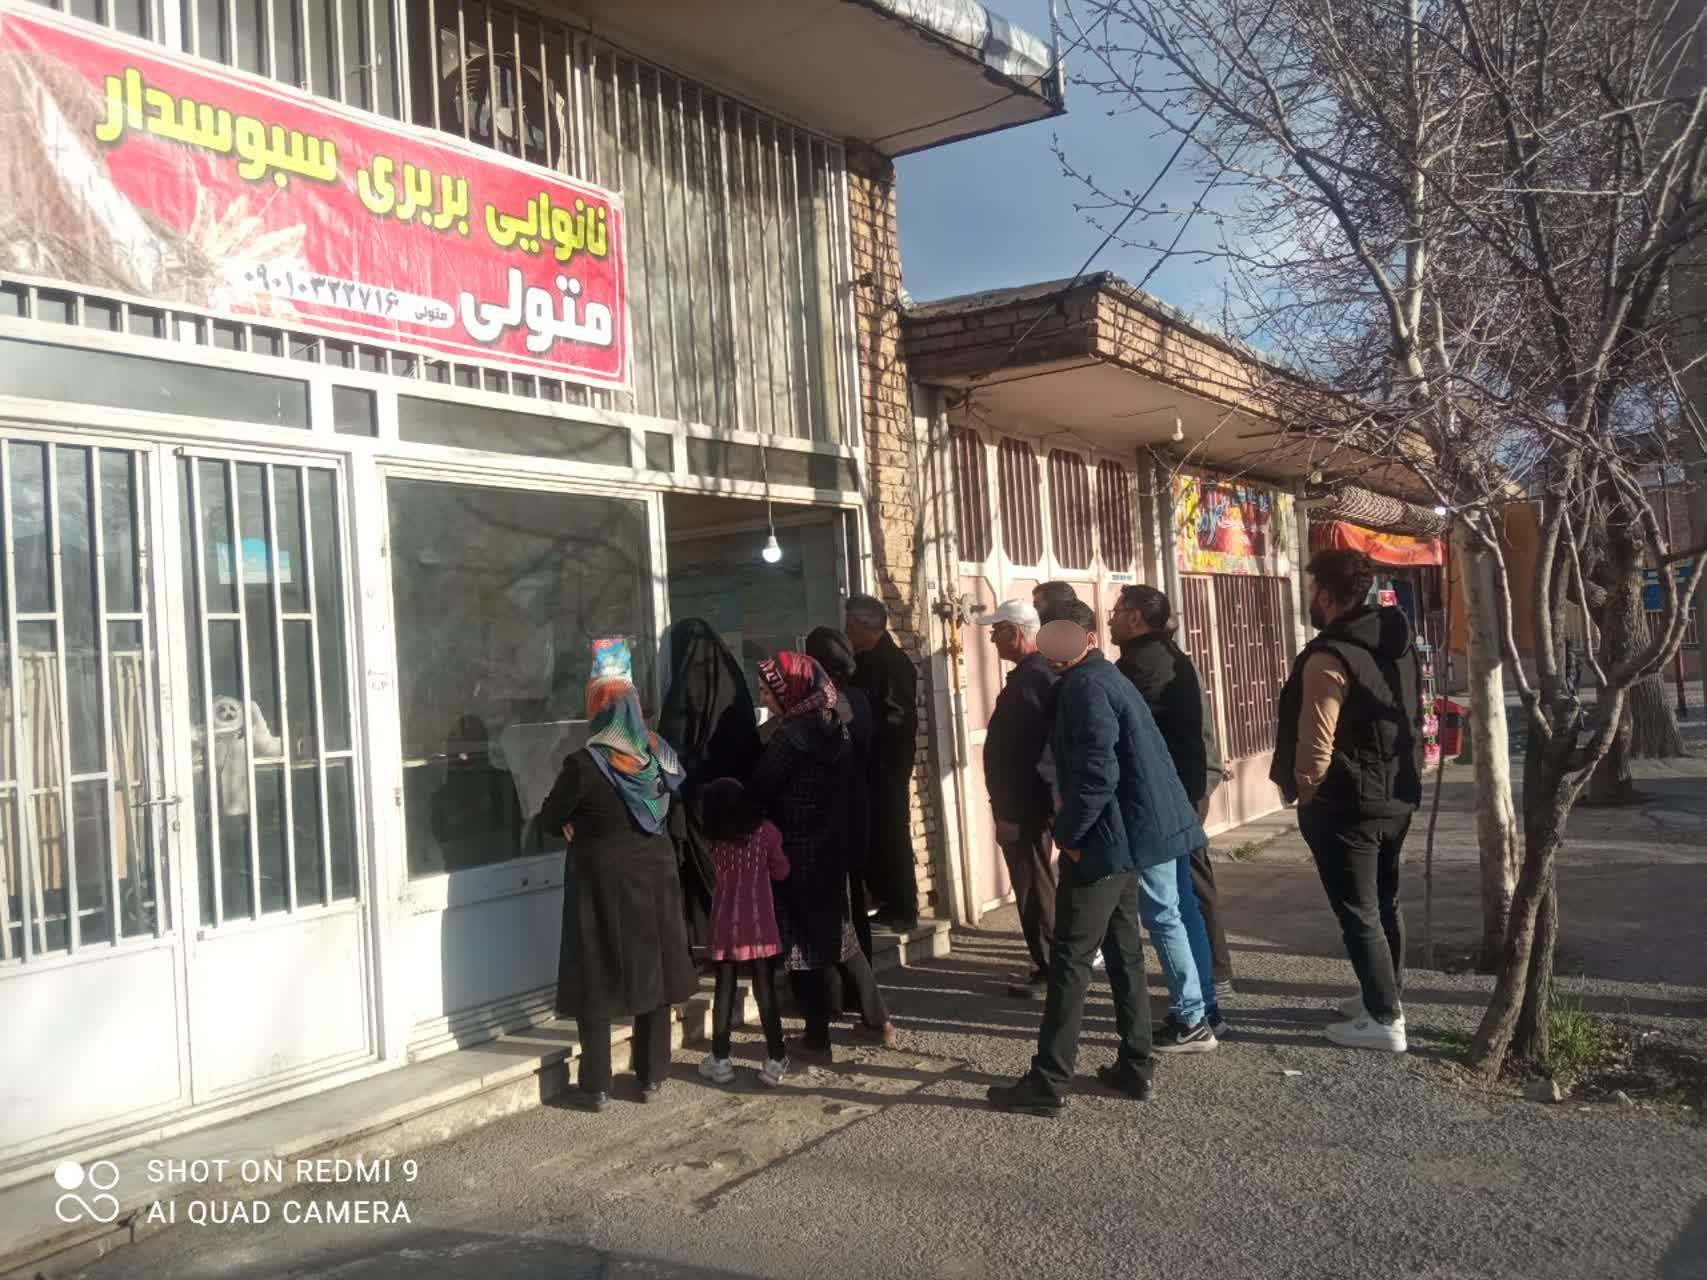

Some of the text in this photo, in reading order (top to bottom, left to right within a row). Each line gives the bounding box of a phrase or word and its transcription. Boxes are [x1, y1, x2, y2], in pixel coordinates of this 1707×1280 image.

[95, 66, 608, 262] نانوایی بربری سبوسدار
[414, 304, 448, 322] متولی
[459, 267, 614, 353] متولی
